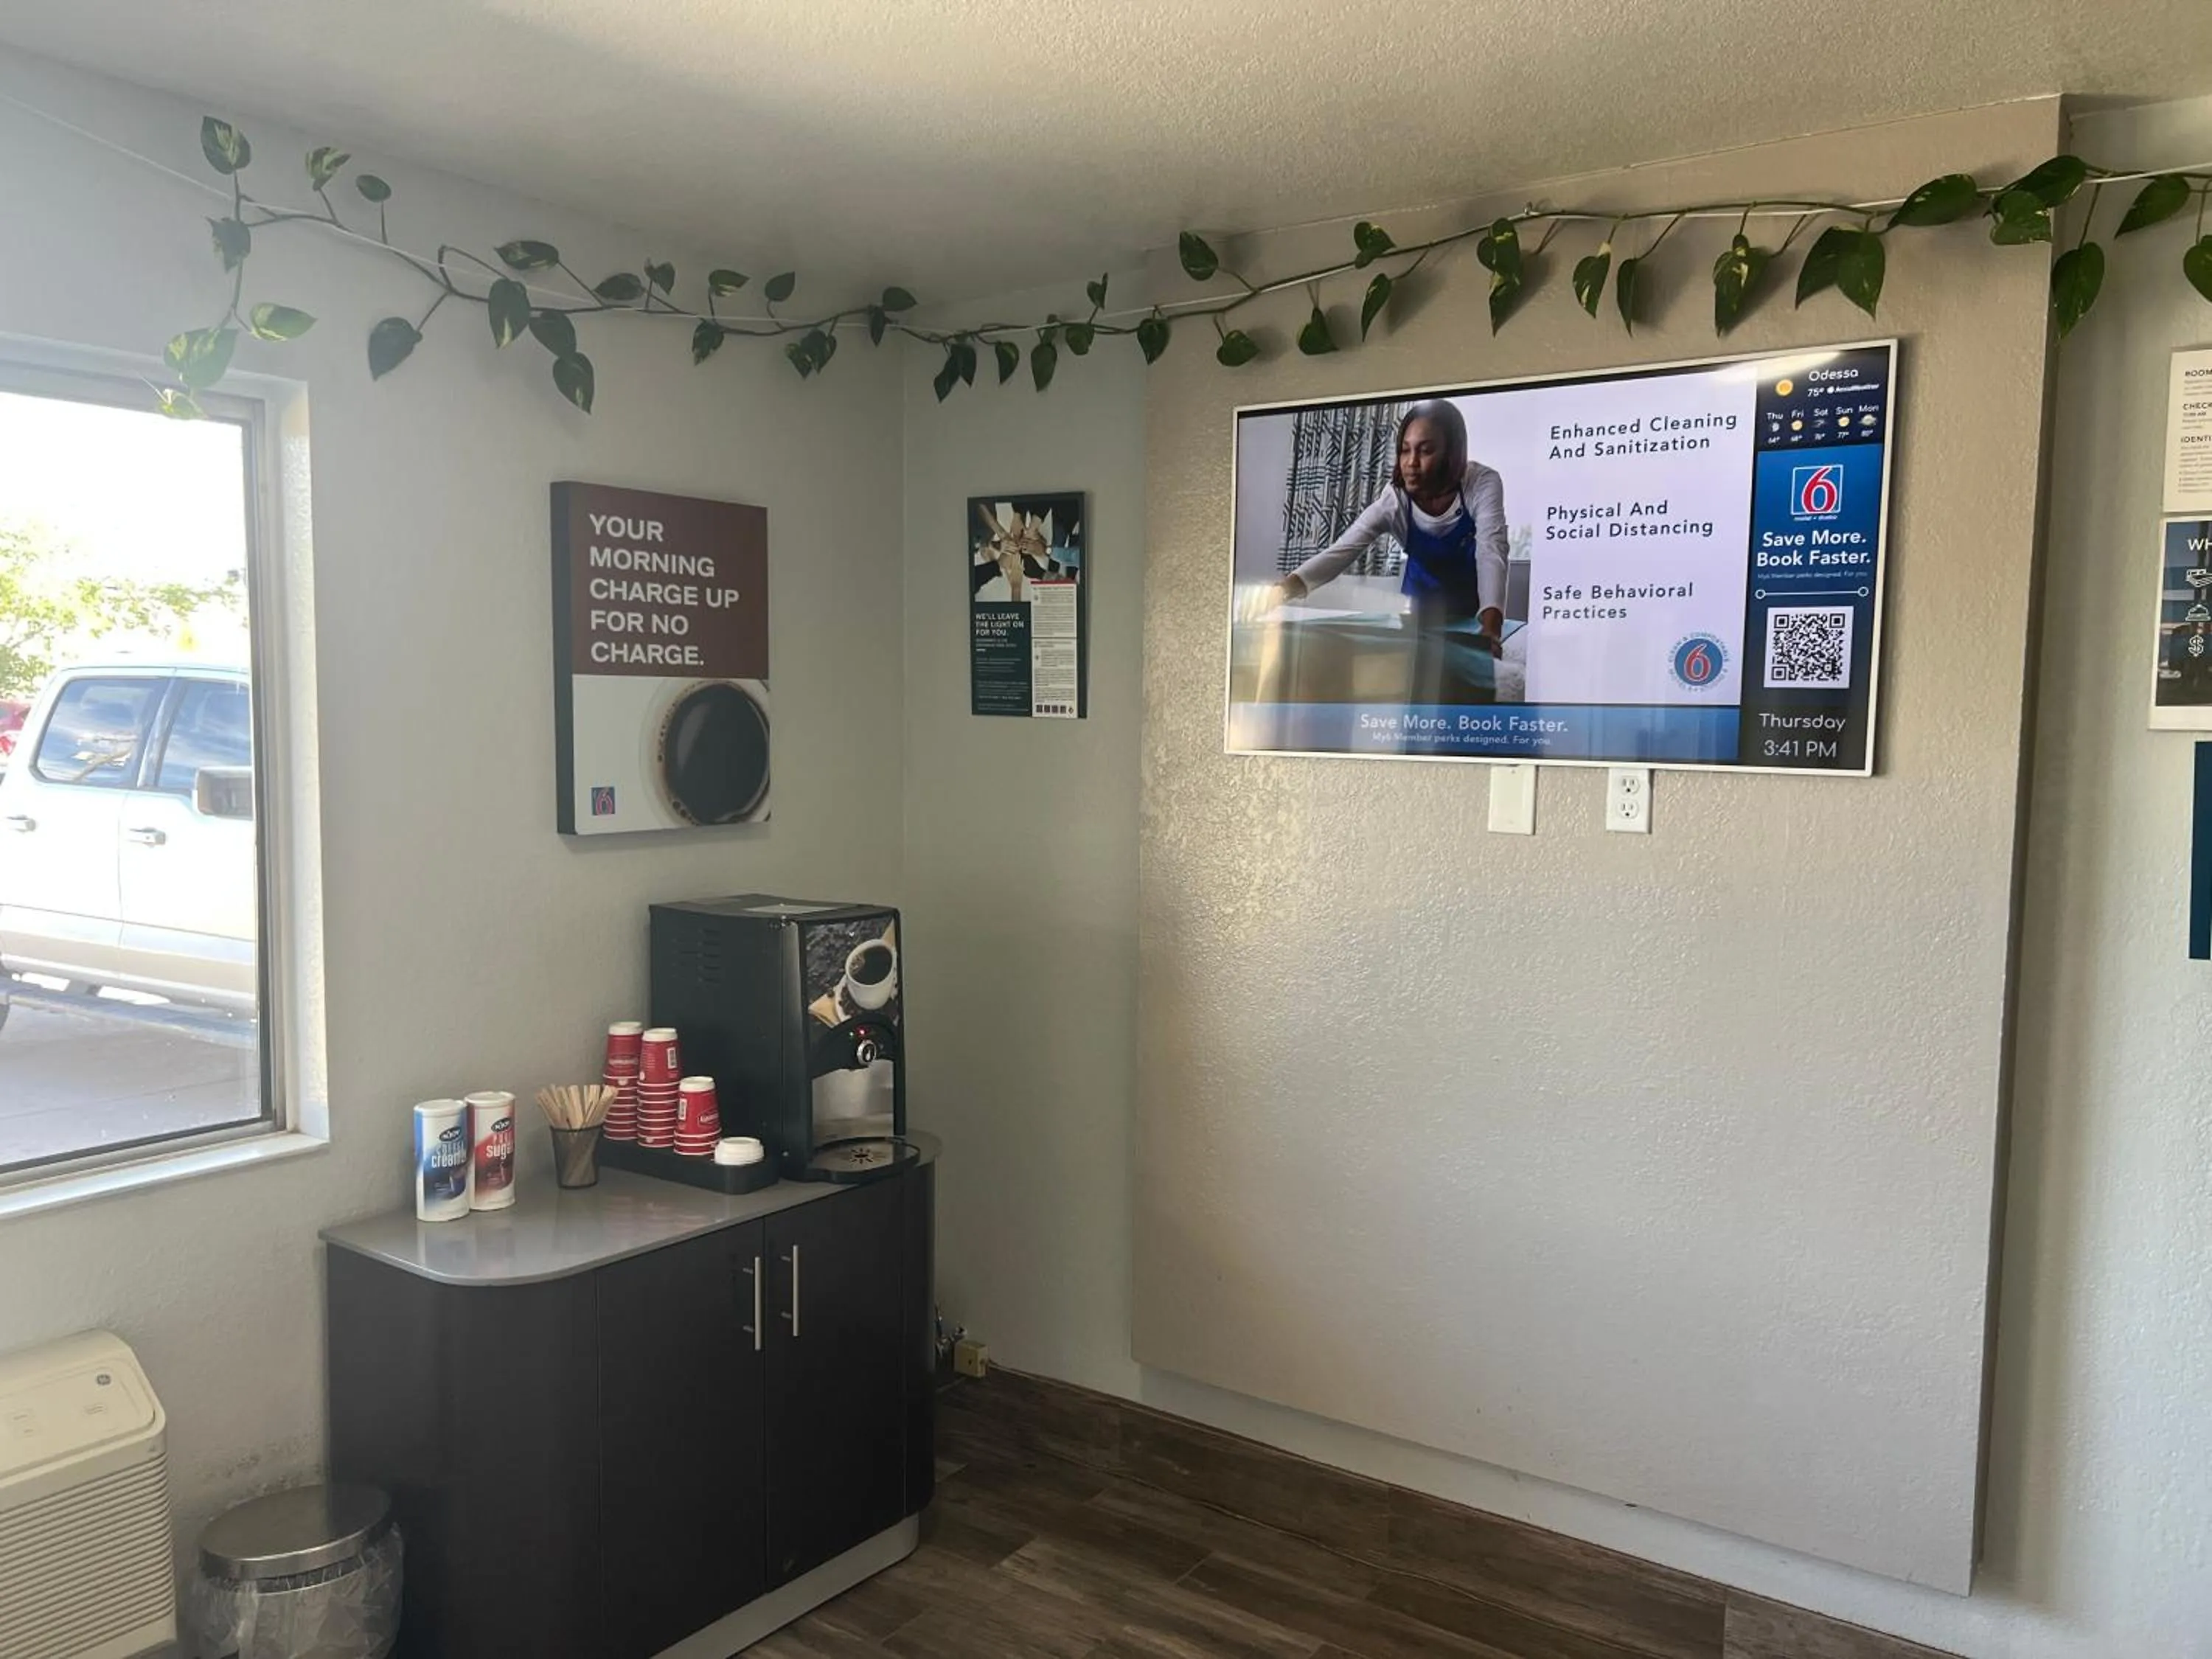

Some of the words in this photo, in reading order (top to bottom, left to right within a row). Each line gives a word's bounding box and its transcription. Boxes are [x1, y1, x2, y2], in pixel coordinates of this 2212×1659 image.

[1809, 369, 1859, 381] Odessa
[1792, 409, 1804, 418] Fri
[1814, 408, 1829, 417] Sat
[1836, 406, 1854, 414] Sun
[1551, 419, 1641, 440] Enhanced
[1650, 413, 1737, 430] Cleaning
[1549, 443, 1585, 459] And
[1594, 436, 1711, 456] Sanitization
[1801, 465, 1838, 514] 6
[1547, 502, 1621, 524] Physical
[1630, 500, 1668, 516] And
[589, 513, 664, 542] YOUR
[1546, 524, 1600, 540] Social
[1610, 519, 1714, 538] Distancing
[1762, 532, 1805, 547] Save
[1811, 529, 1867, 545] More.
[590, 546, 715, 577] MORNING
[1756, 549, 1803, 567] Book
[1809, 550, 1871, 566] Faster.
[590, 578, 699, 606] CHARGE
[706, 588, 740, 608] UP
[1543, 585, 1582, 600] Safe
[1592, 582, 1693, 599] Behavioral
[1543, 605, 1627, 619] Practices
[591, 610, 644, 633] FOR
[652, 613, 689, 636] NO
[591, 641, 704, 666] CHARGE.
[1684, 643, 1711, 682] 6
[1360, 714, 1397, 729] Save
[1403, 714, 1451, 730] More.
[1459, 715, 1501, 731] Book
[1509, 716, 1568, 732] Faster.
[1759, 713, 1846, 731] Thursday
[1434, 734, 1460, 743] perks
[1512, 735, 1531, 744] For
[1763, 740, 1799, 757] 3:41
[1806, 741, 1837, 758] PM
